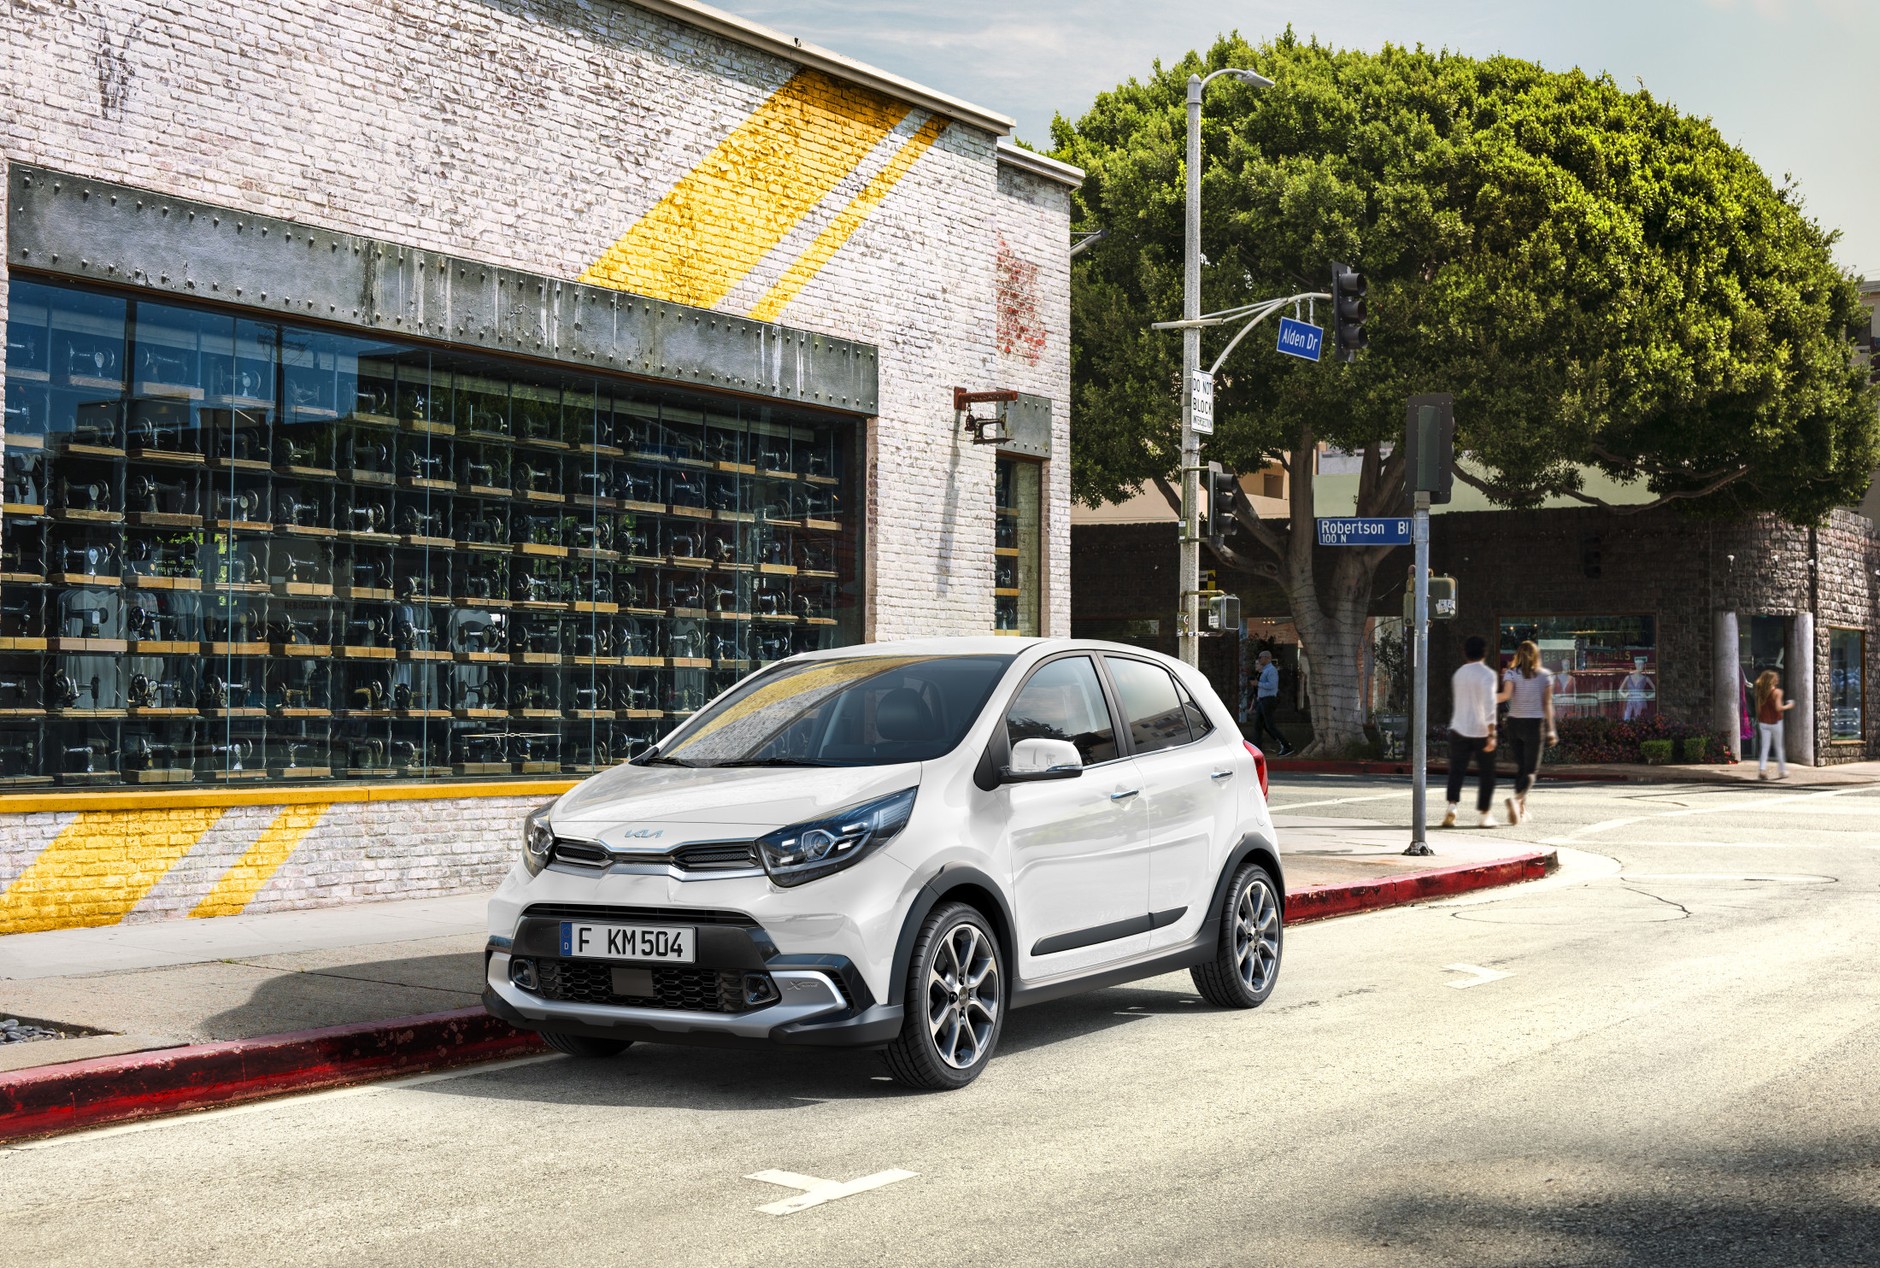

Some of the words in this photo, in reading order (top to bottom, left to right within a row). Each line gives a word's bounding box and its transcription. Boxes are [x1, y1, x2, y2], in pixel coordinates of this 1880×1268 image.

[1281, 327, 1305, 348] Alden
[1306, 333, 1318, 351] Dr
[1192, 377, 1201, 393] DO
[1202, 381, 1212, 396] NOT
[1192, 397, 1213, 416] BLOCK
[1321, 520, 1385, 535] Robertson
[1397, 521, 1409, 535] Bl
[1322, 534, 1337, 544] 100
[1340, 534, 1347, 544] N
[564, 941, 570, 950] D
[579, 927, 592, 953] F
